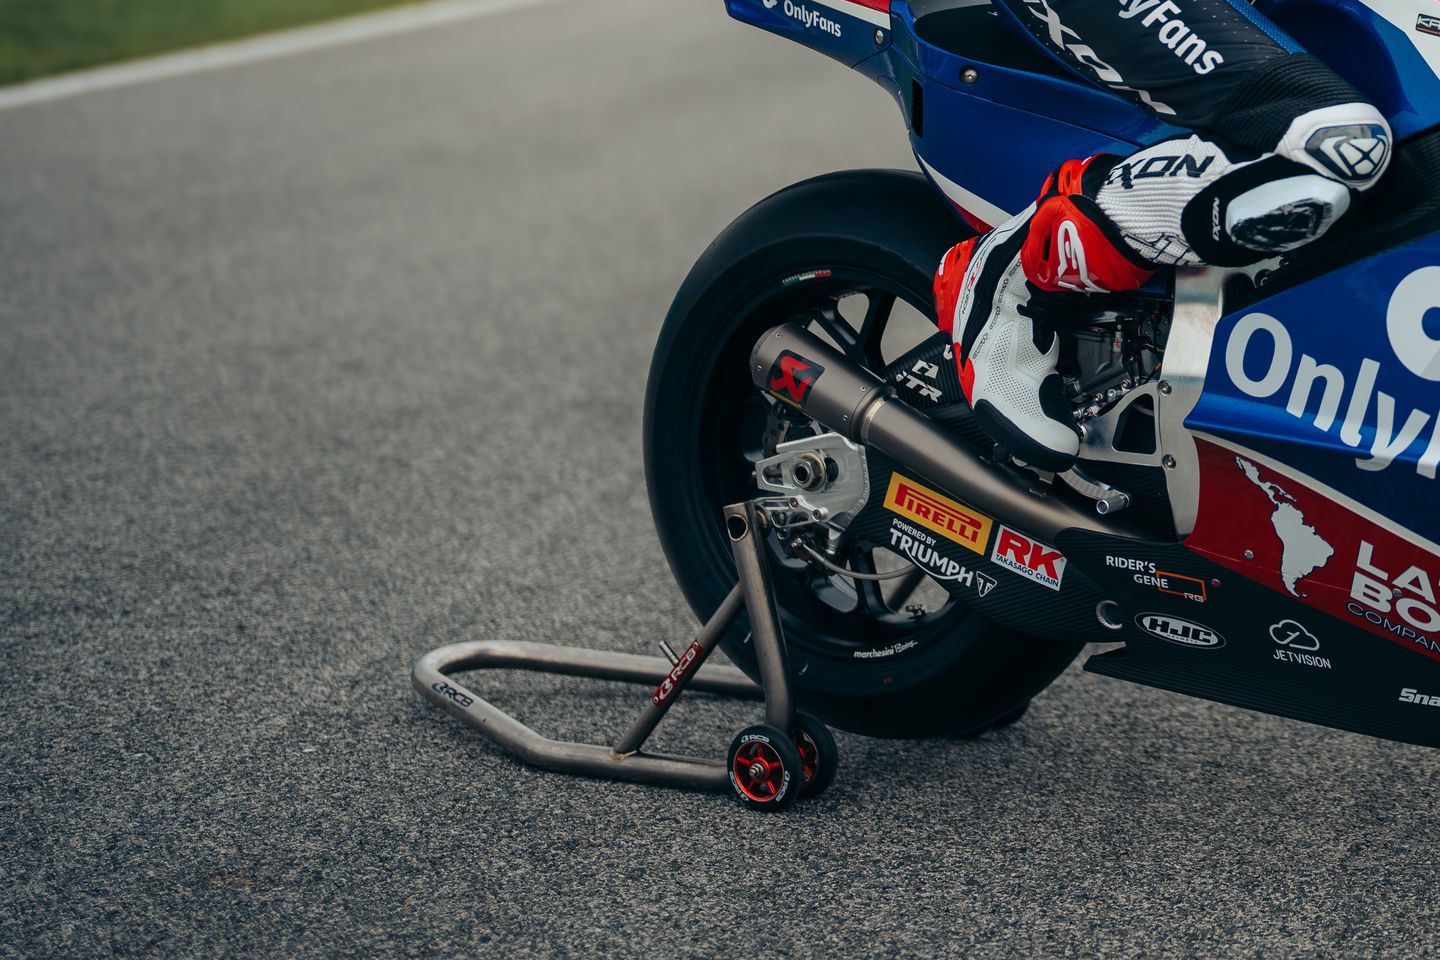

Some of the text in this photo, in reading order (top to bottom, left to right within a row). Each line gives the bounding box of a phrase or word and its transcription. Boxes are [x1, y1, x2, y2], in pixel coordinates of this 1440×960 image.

[783, 0, 842, 38] OnlyFans
[893, 481, 983, 544] PIRELLI
[892, 517, 937, 547] POWERED BY
[889, 527, 975, 588] TRIUMPH
[996, 527, 1064, 581] RK
[1105, 555, 1158, 575] RIDER'S
[995, 553, 1060, 588] TAKASAGO CHAIN
[1133, 572, 1170, 590] GENE
[1183, 591, 1206, 603] RG
[1148, 617, 1213, 644] HJC
[670, 647, 697, 682] RCB
[1272, 648, 1332, 670] JETVISION
[444, 686, 474, 708] RCB
